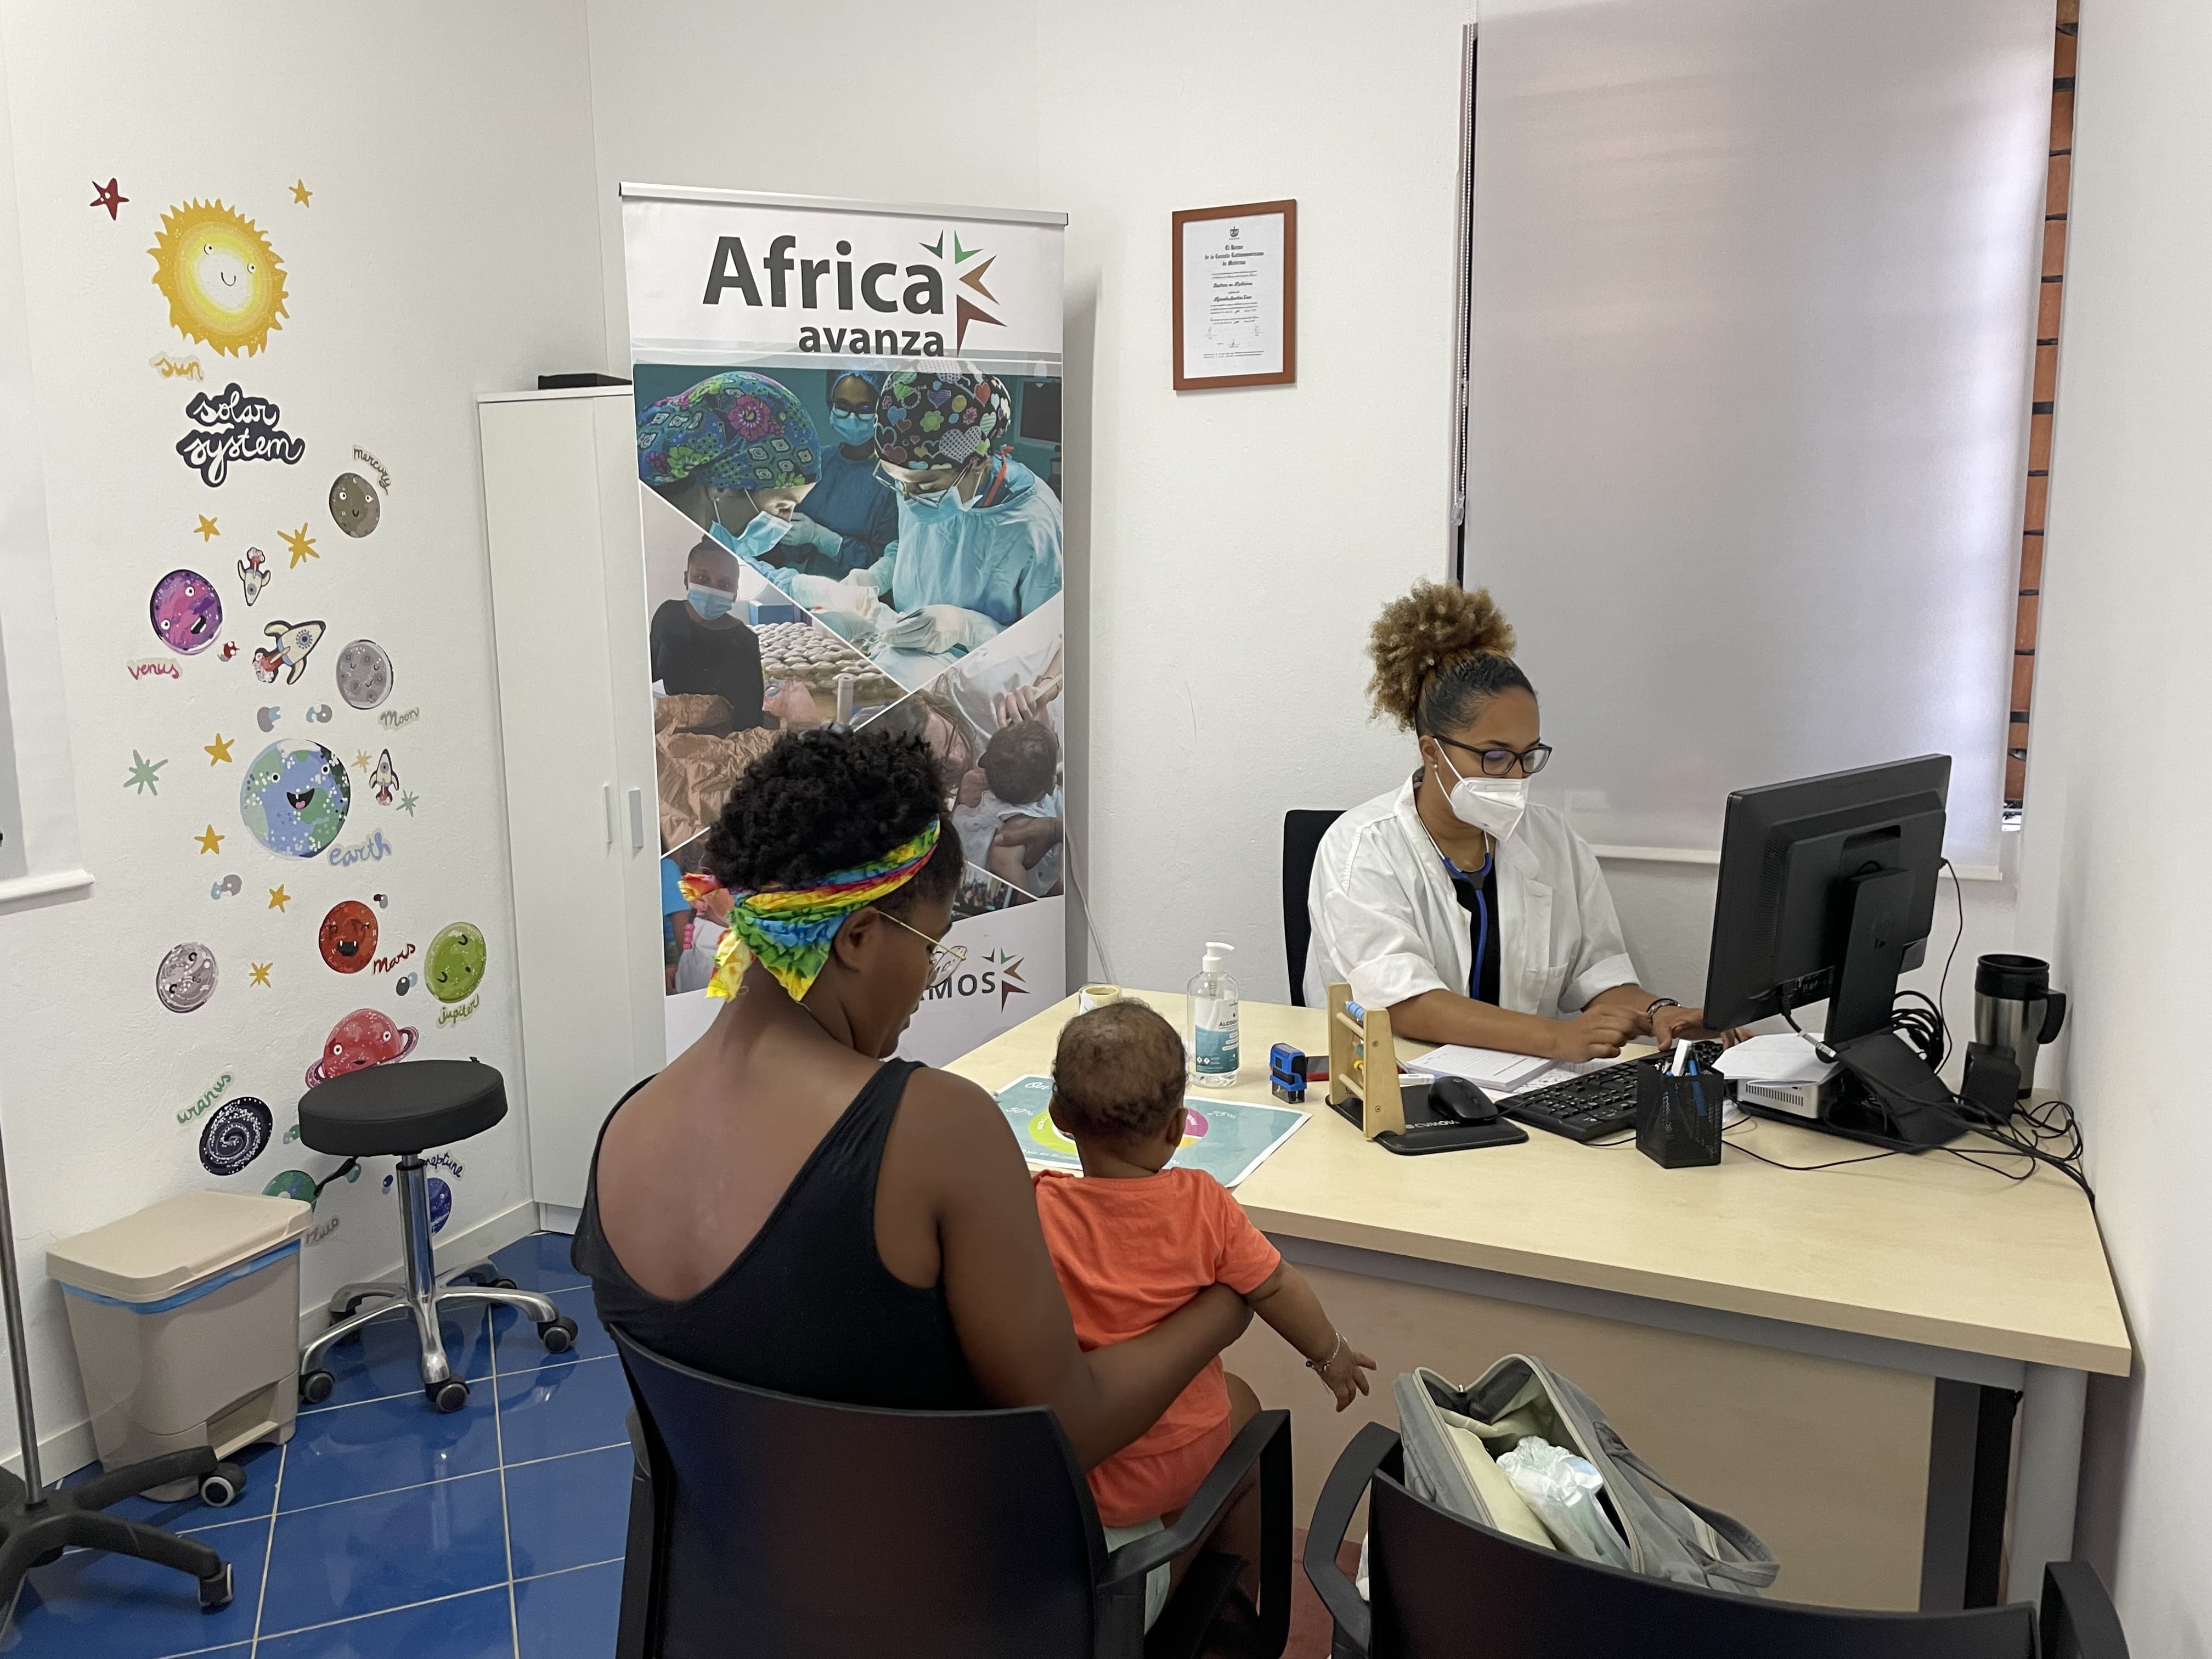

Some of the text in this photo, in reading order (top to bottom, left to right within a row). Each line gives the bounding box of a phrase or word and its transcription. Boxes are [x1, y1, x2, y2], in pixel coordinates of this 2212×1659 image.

[703, 235, 944, 315] Africa
[799, 326, 945, 357] avanza
[154, 358, 204, 381] sun
[193, 390, 277, 426] solar
[183, 427, 302, 484] system
[127, 663, 179, 680] venus
[329, 832, 391, 866] earth
[438, 994, 480, 1025] jupiter
[177, 1075, 231, 1124] uranus
